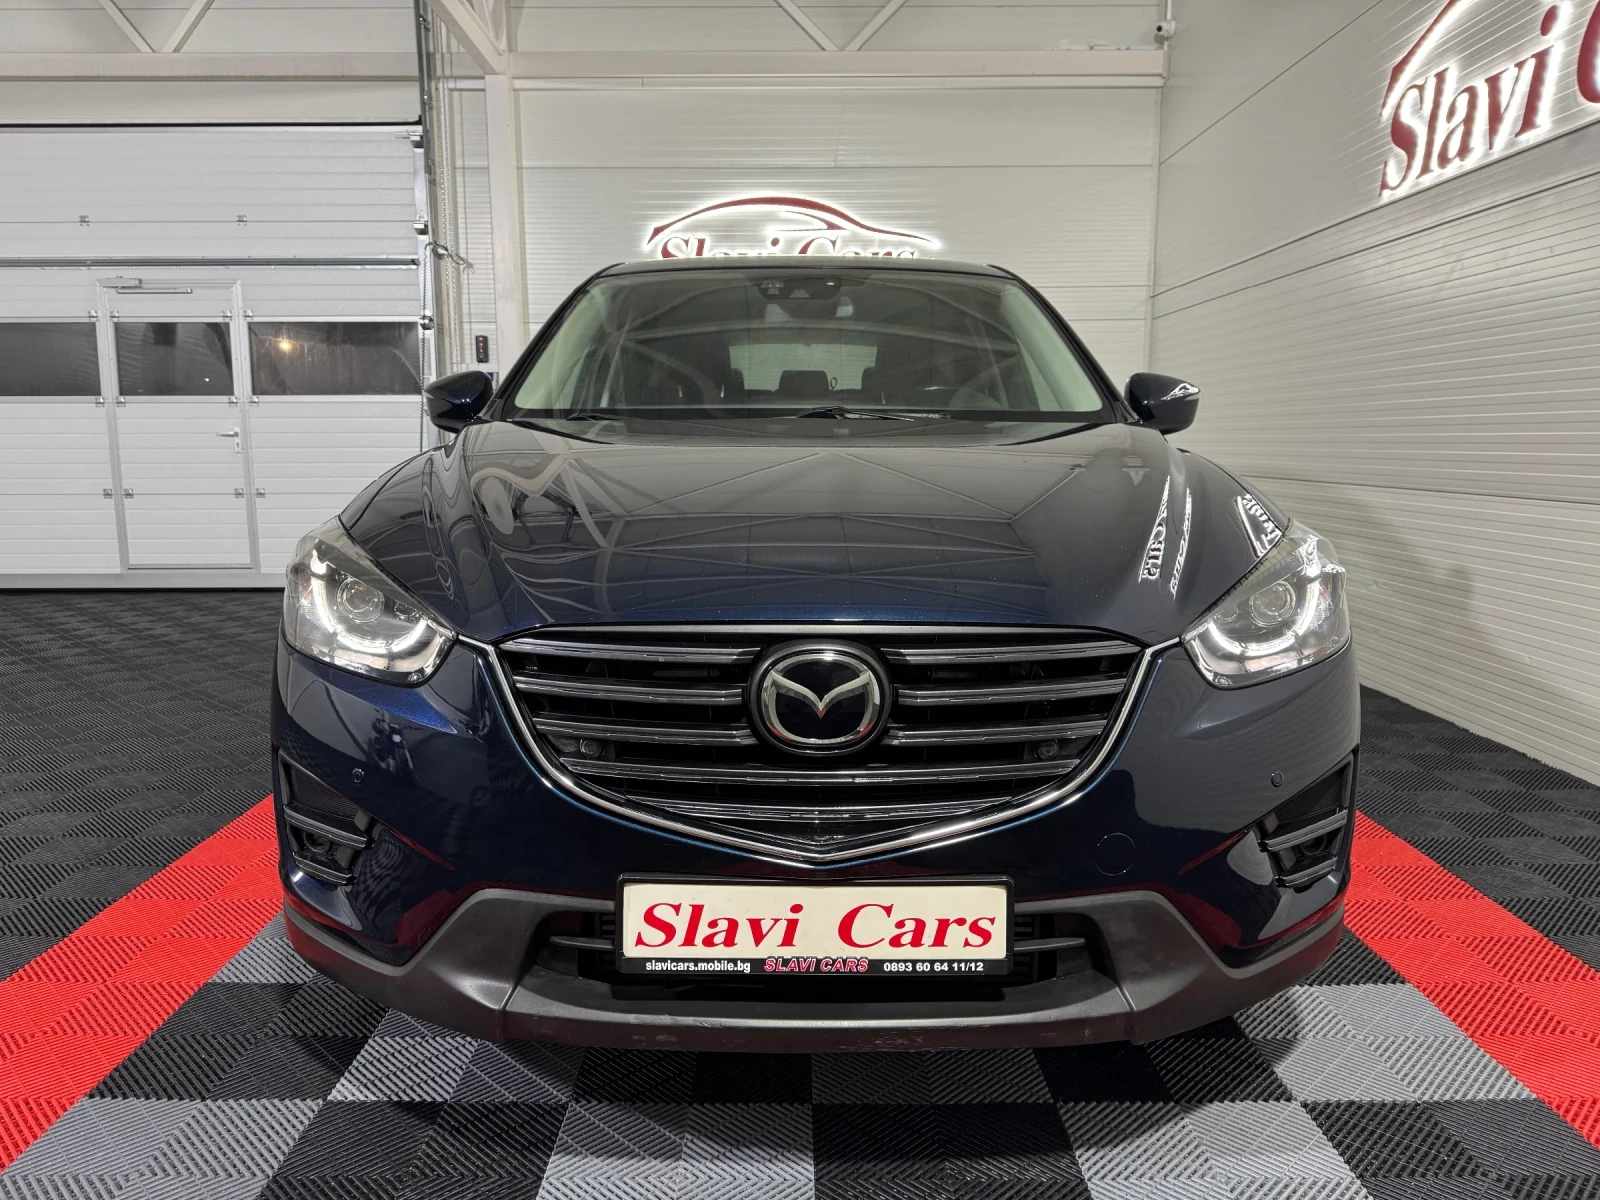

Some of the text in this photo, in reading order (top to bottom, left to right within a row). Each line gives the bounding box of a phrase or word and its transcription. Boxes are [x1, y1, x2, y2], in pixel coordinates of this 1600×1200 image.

[1379, 5, 1558, 198] Slavi
[634, 902, 997, 949] Slavi Cars
[645, 956, 985, 974] slavicars.mobile.bg SLAVI CARS 0893 60 64 11/12
